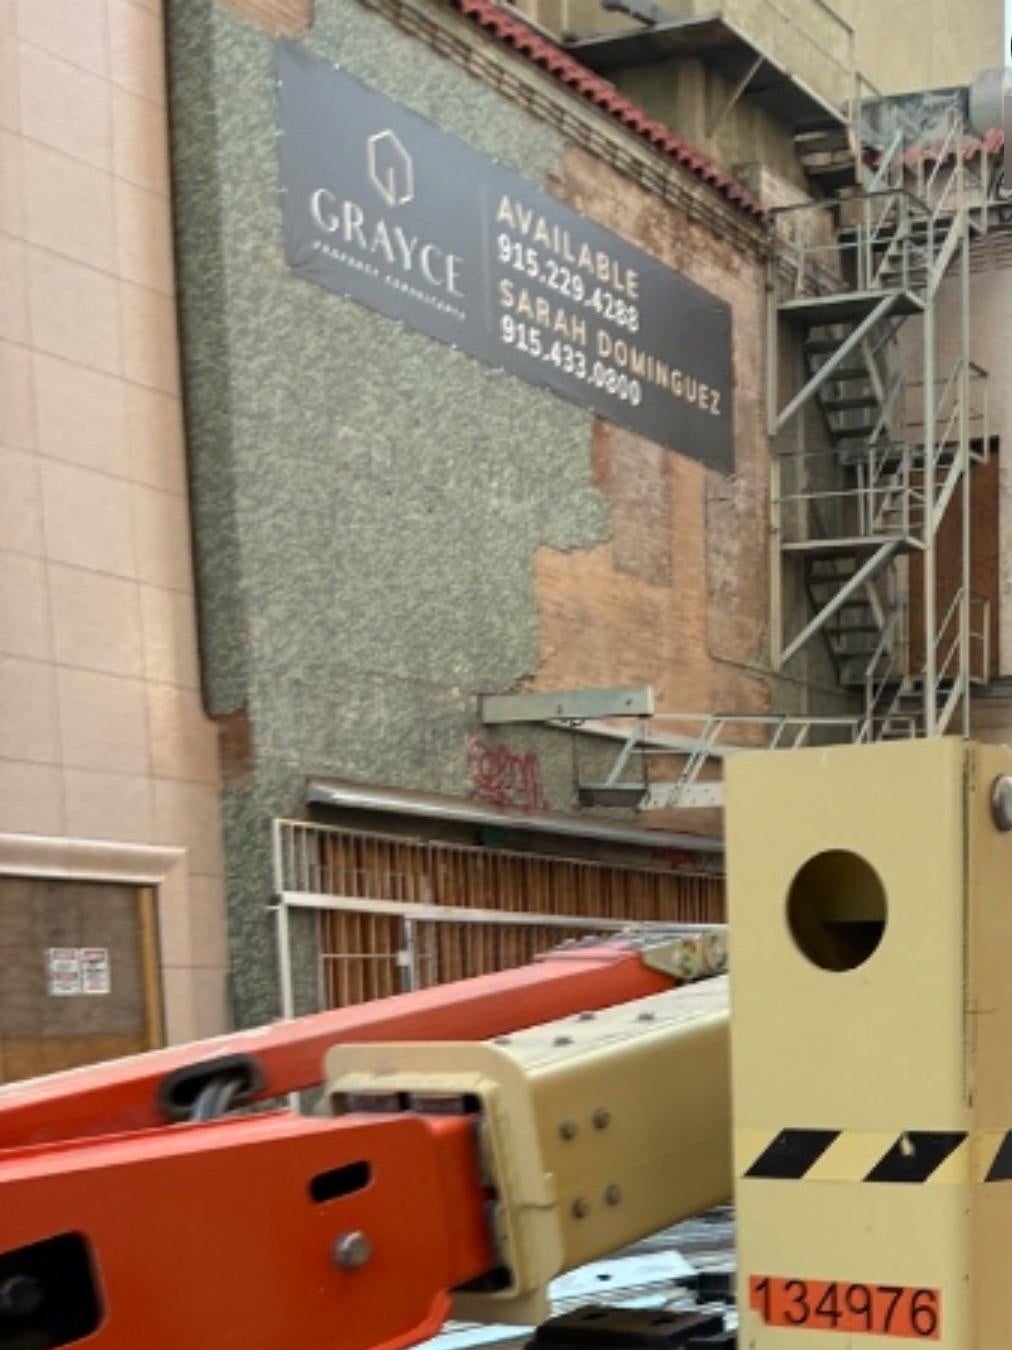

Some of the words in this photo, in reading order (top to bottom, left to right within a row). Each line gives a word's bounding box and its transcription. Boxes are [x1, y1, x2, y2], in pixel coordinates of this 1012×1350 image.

[311, 187, 466, 298] GRAYCE
[497, 195, 640, 299] AVAILABLE
[498, 233, 640, 334] 915.229.4288
[500, 278, 587, 346] SARAH
[597, 329, 721, 415] DOMINGUEZ
[754, 1277, 937, 1336] 134976
